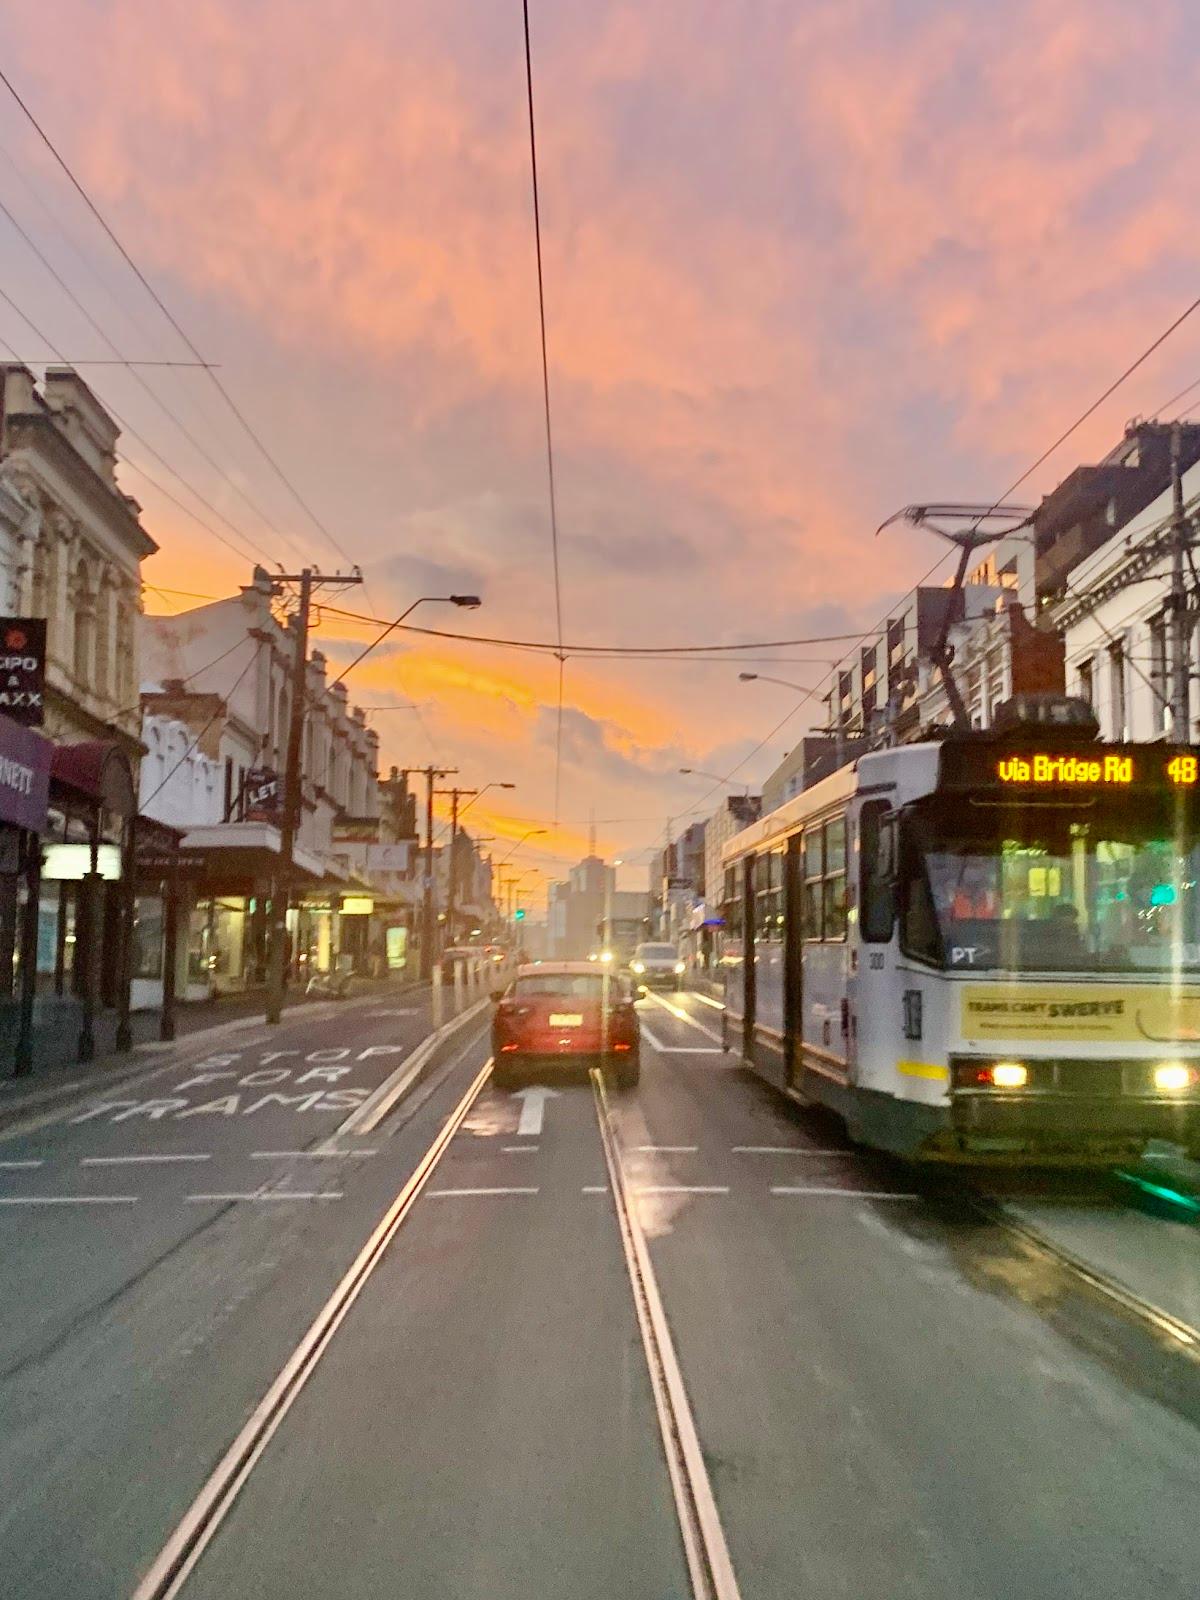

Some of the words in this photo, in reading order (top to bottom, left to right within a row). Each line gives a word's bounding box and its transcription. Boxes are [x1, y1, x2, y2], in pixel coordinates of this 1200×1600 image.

[999, 757, 1030, 782] via
[1033, 755, 1101, 782] Bridge
[1104, 756, 1133, 783] Rd
[1167, 756, 1198, 783] 48
[249, 781, 276, 804] LET
[1048, 1000, 1125, 1017] SWERVE
[195, 1045, 402, 1068] STOP
[172, 1066, 351, 1093] FOR
[68, 1088, 373, 1125] TRAMS
